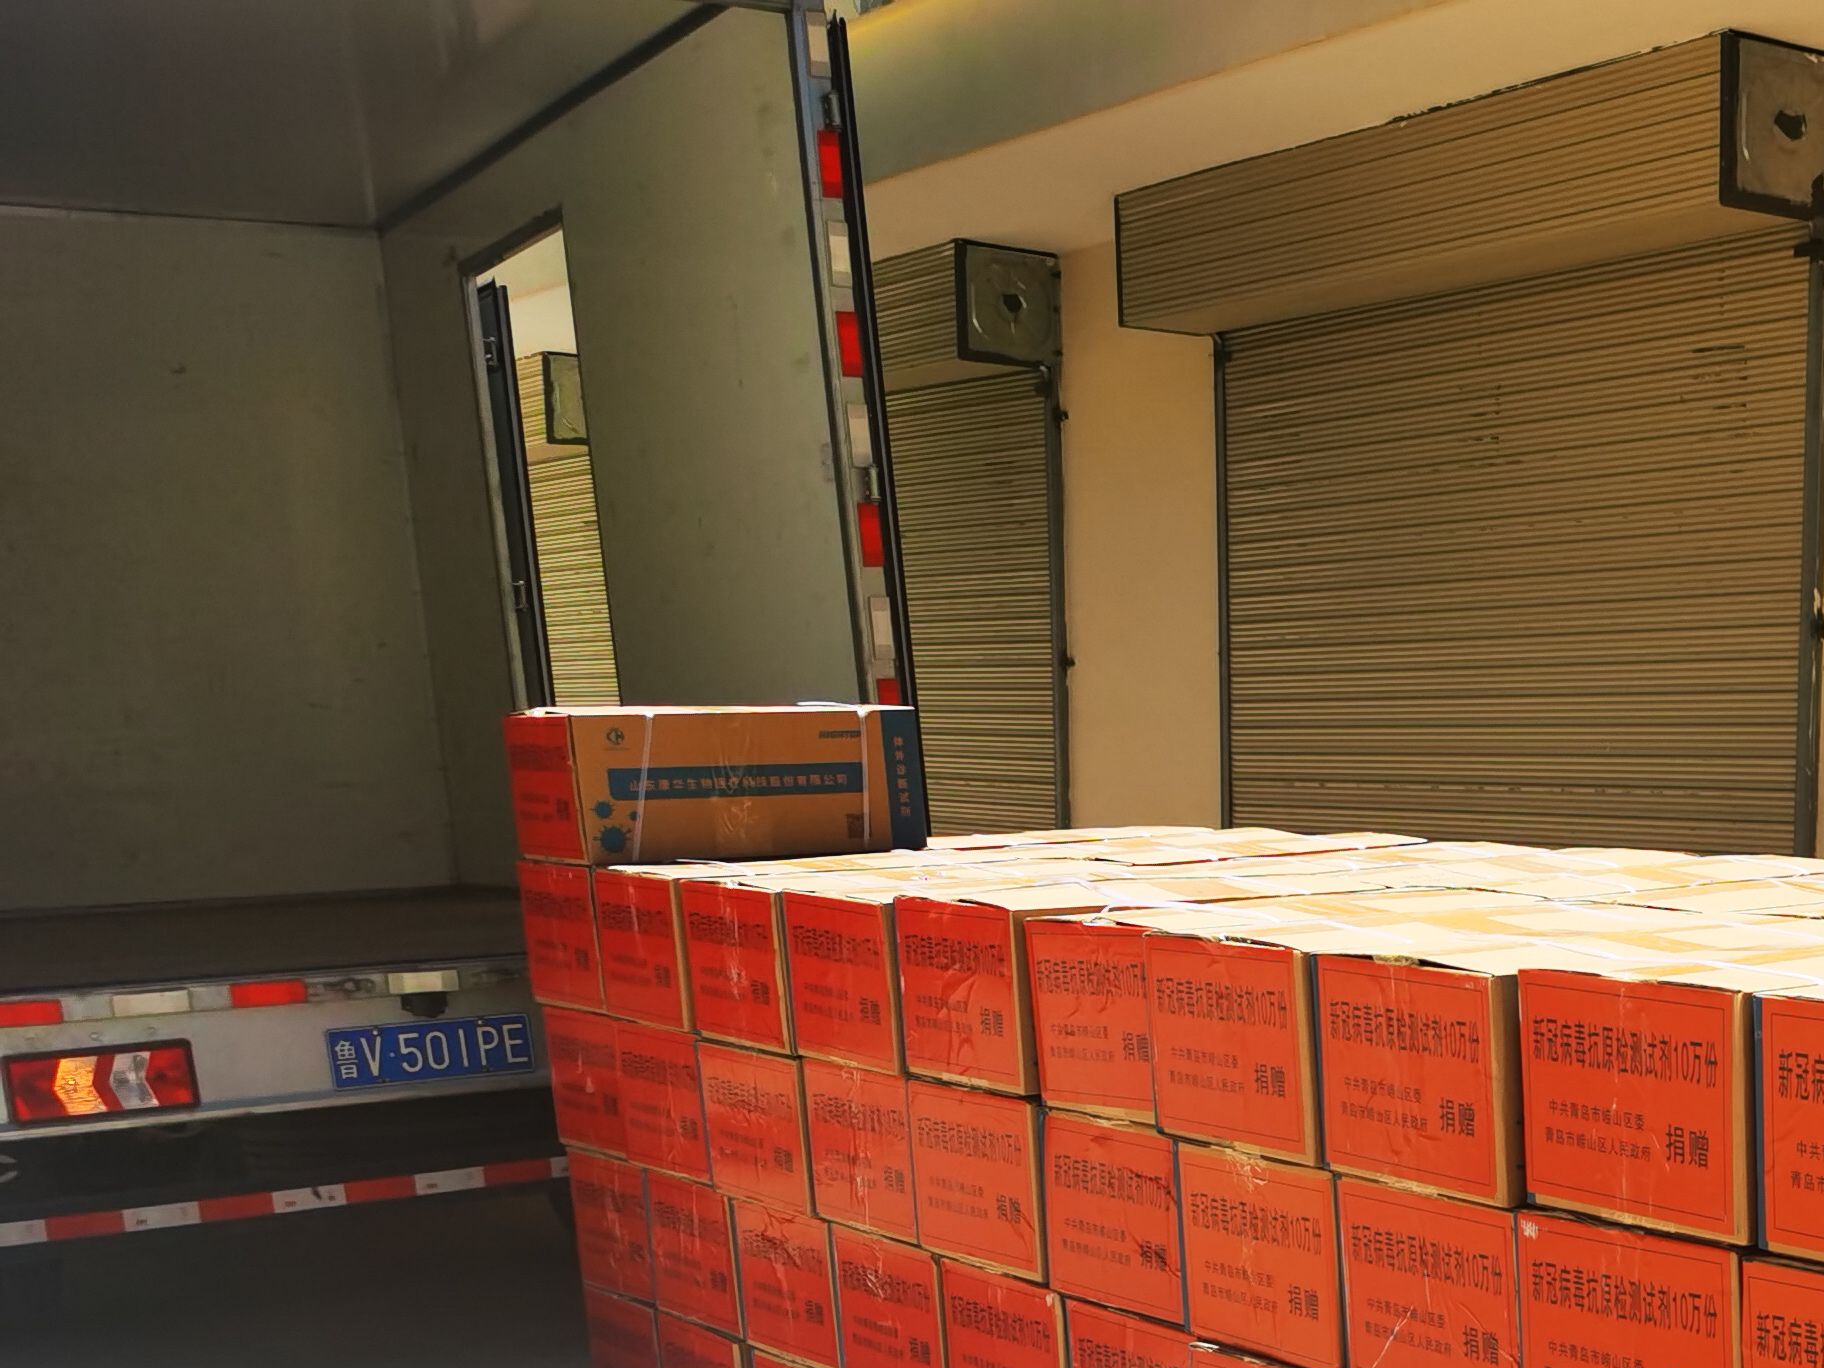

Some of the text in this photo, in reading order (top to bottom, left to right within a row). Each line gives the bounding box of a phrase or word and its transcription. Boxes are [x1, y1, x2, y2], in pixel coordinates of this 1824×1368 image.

[1531, 1014, 1718, 1089] 新冠病毒抗原检测试剂10万份
[1438, 1095, 1475, 1140] 捐赠
[1664, 1122, 1709, 1170] 捐赠
[1530, 1258, 1717, 1339] 新冠病毒抗原检测试剂10万份
[1461, 1323, 1499, 1368] 捐赠
